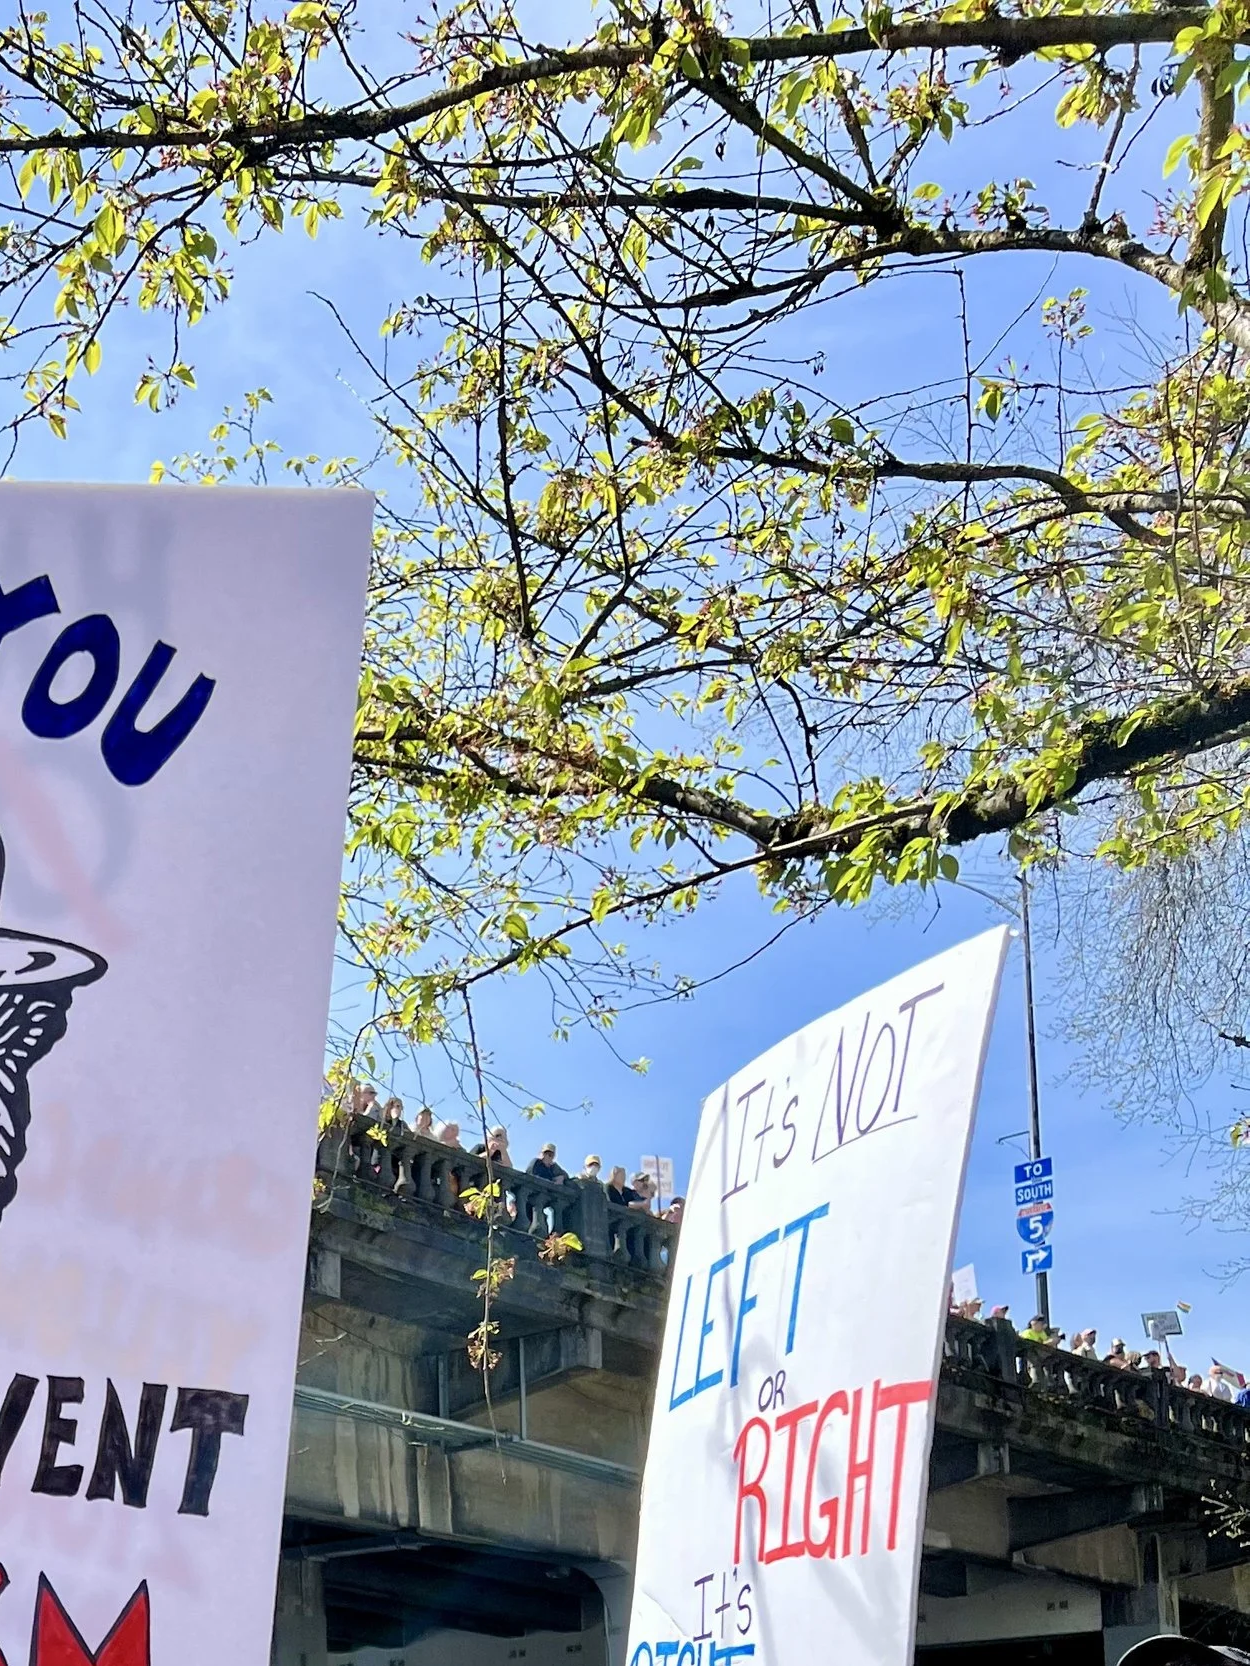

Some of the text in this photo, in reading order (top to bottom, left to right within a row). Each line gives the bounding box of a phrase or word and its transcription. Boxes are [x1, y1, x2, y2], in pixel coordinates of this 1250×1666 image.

[812, 984, 944, 1163] NOT
[1017, 1183, 1051, 1202] SOUTH
[1023, 1163, 1042, 1178] TO
[1030, 1215, 1043, 1239] 5
[669, 1202, 829, 1411] LEFT
[758, 1369, 786, 1413] OR
[733, 1379, 932, 1565] RIGHT
